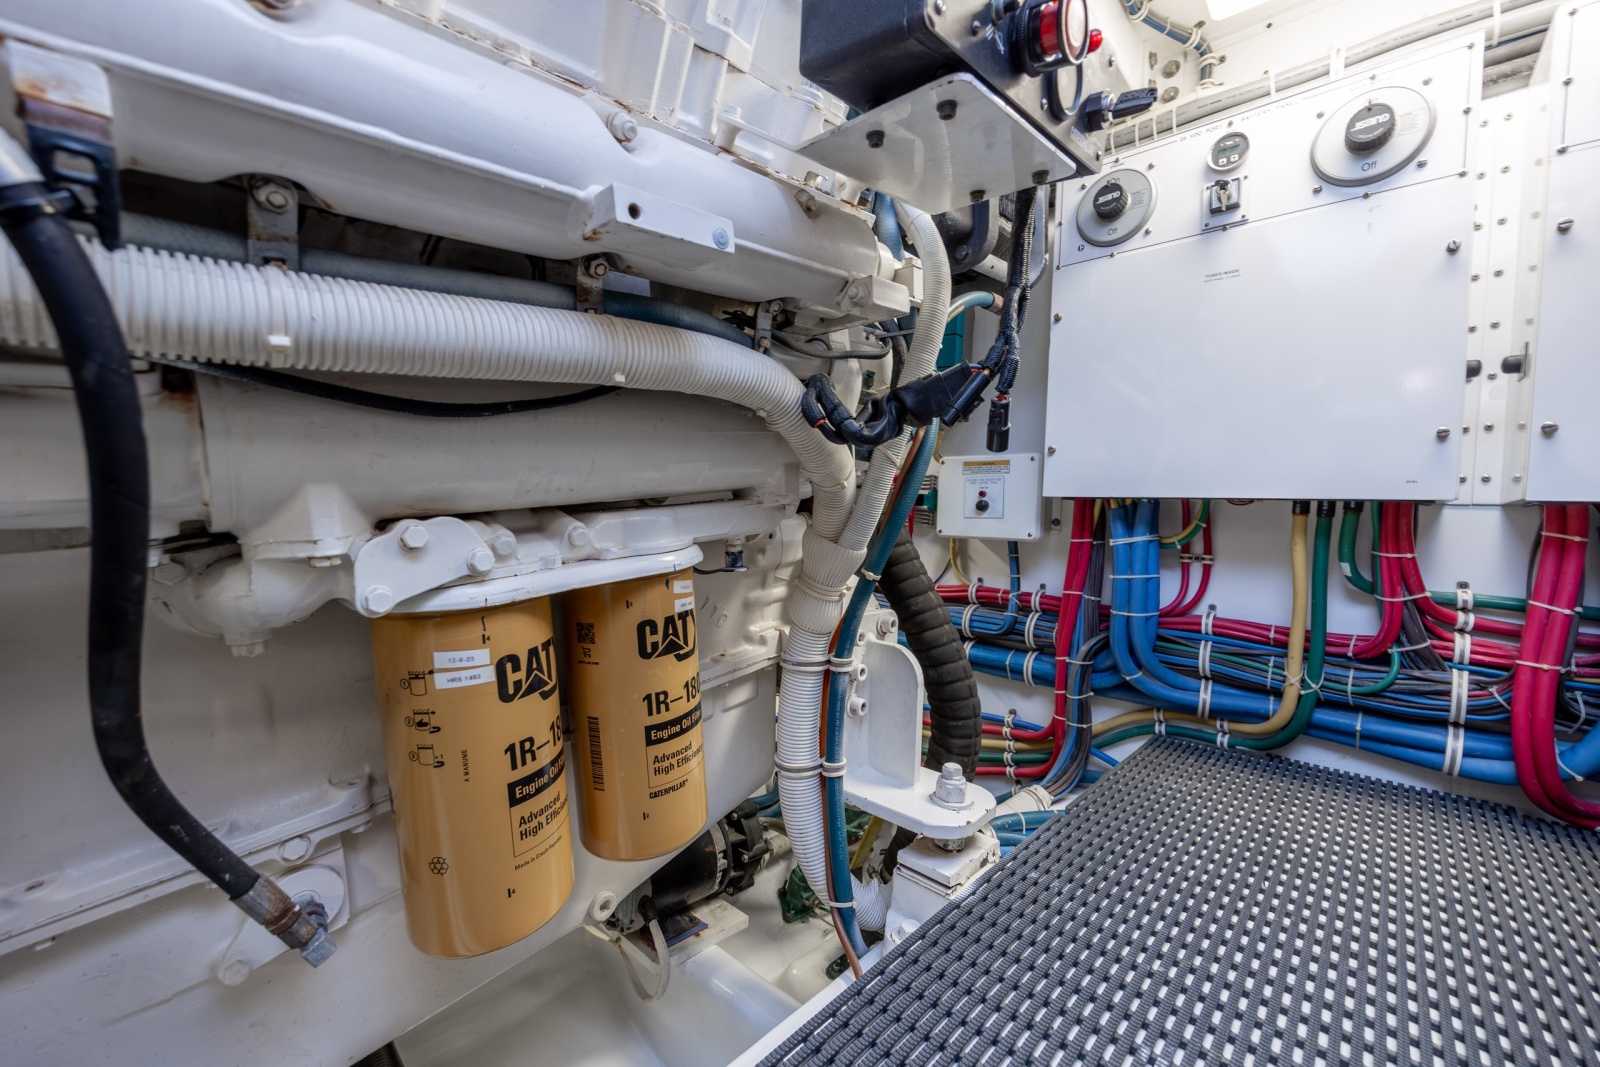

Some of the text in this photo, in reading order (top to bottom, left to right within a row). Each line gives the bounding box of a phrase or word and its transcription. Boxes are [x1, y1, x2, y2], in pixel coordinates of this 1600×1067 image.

[1361, 160, 1378, 172] Off
[1107, 227, 1118, 236] Off
[637, 610, 692, 661] CAT
[446, 676, 463, 684] HRS
[496, 636, 555, 703] CAT
[651, 724, 681, 740] Engine
[682, 716, 691, 729] Oil
[653, 741, 692, 765] Advanced
[515, 774, 549, 798] Engine
[550, 761, 559, 778] Oil
[654, 761, 675, 776] High
[518, 791, 560, 828] Advanced
[520, 819, 543, 841] High
[514, 860, 530, 870] Made
